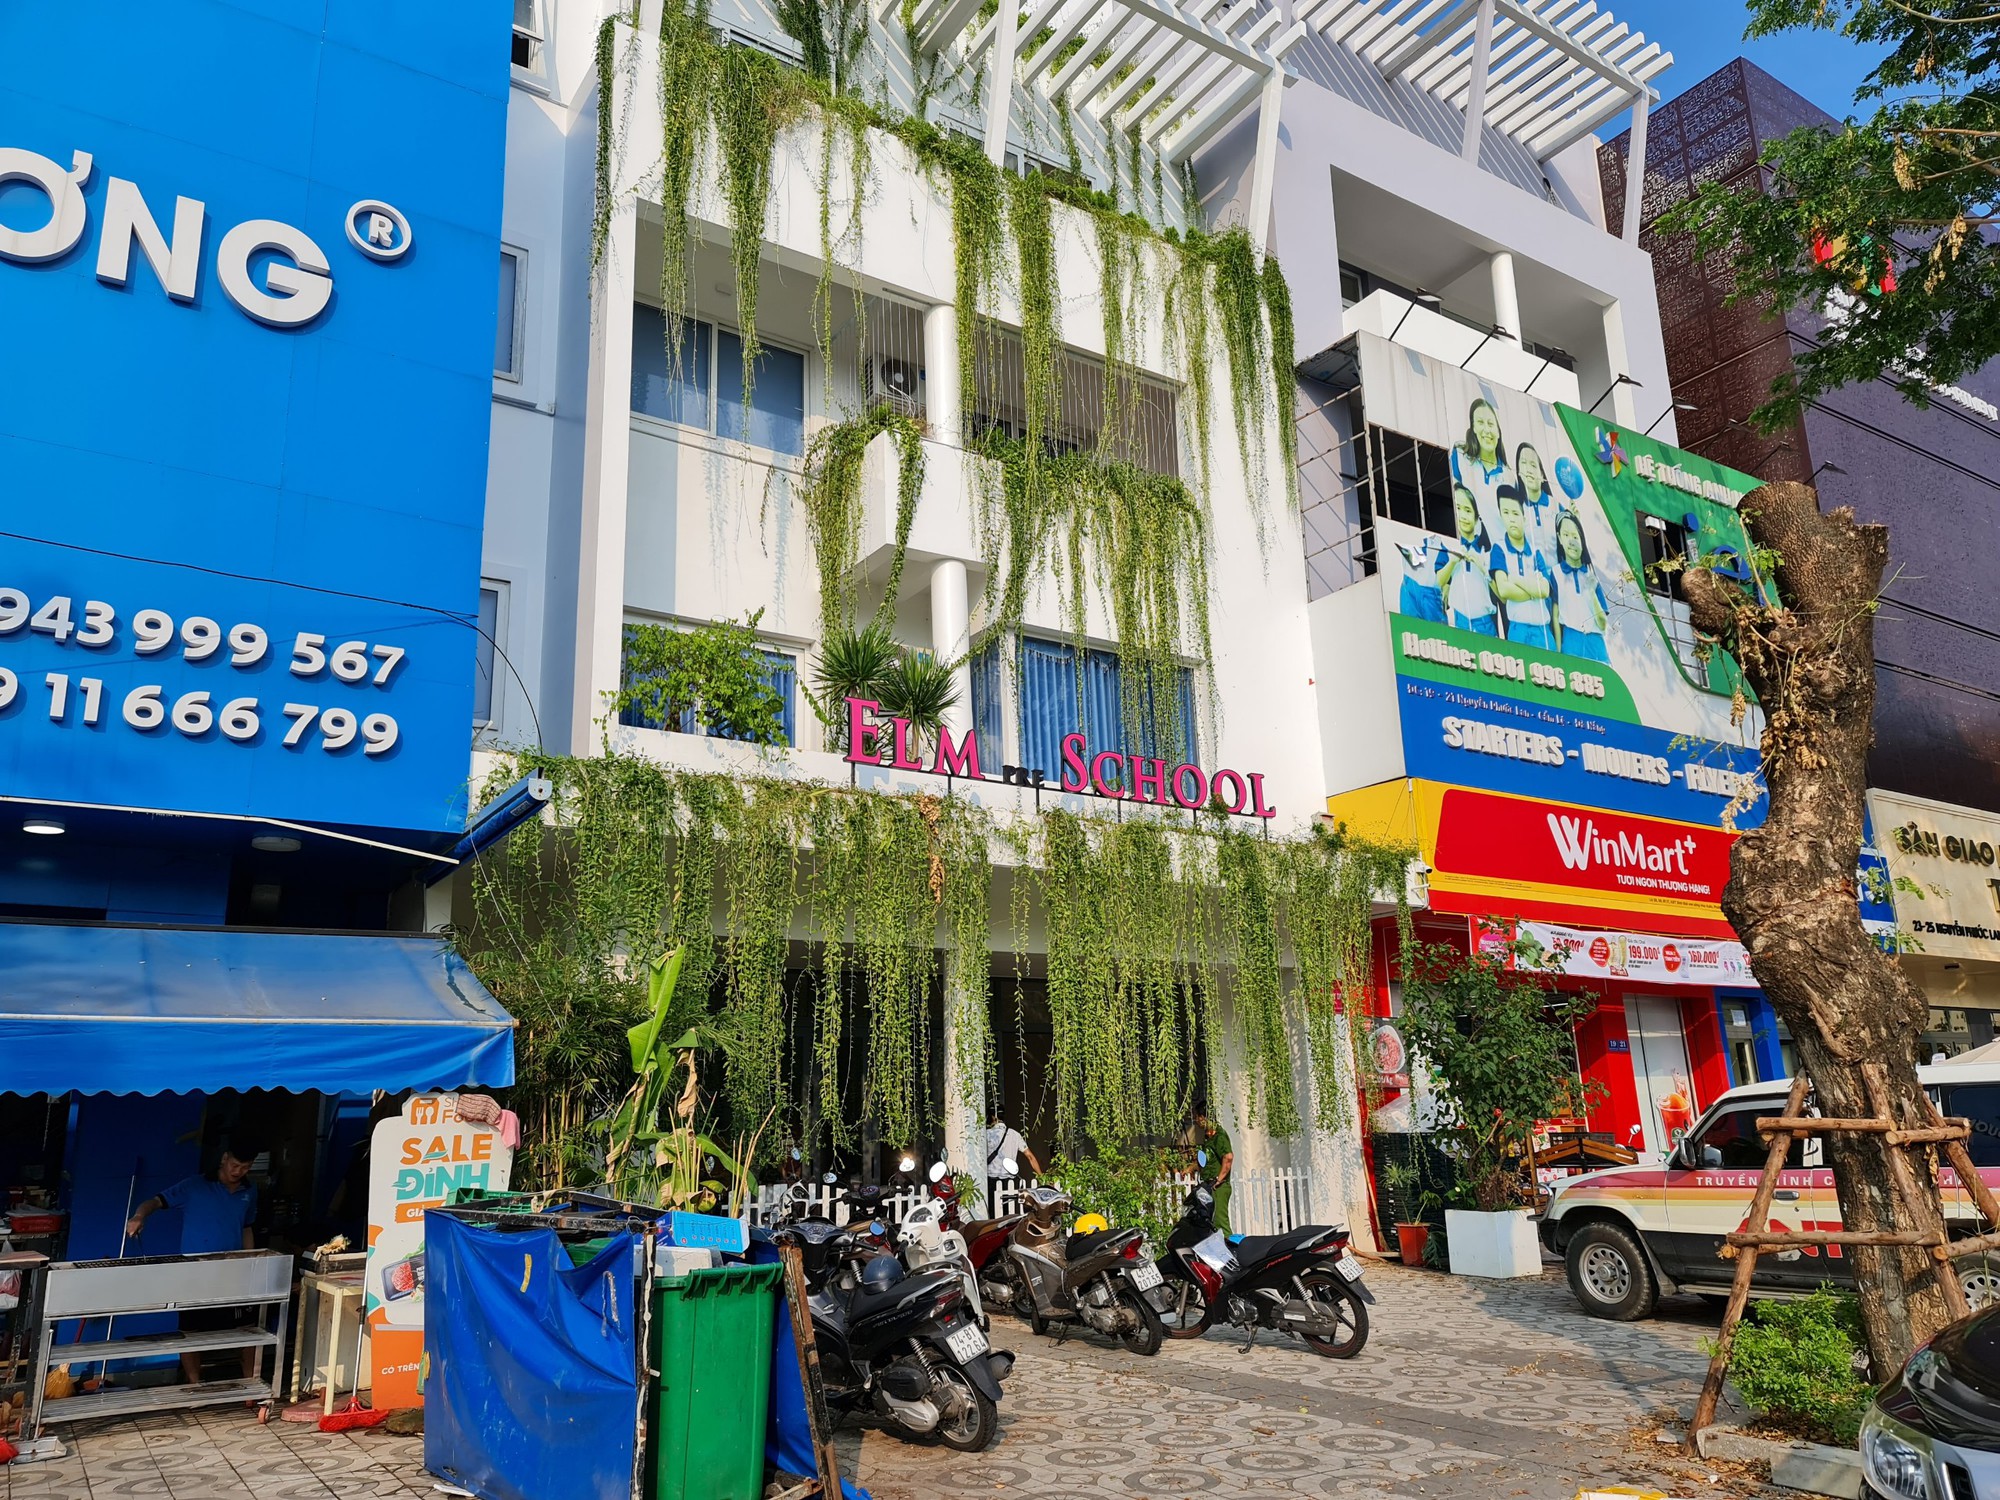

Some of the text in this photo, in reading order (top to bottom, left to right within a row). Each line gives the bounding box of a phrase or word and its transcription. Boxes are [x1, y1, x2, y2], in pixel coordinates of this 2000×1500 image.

[133, 609, 270, 667] 999
[289, 632, 405, 686] 567
[1401, 631, 1606, 699] Hotline: 0901 996 885
[45, 673, 104, 724] 11
[122, 685, 261, 742] 666
[281, 702, 400, 757] 799
[843, 696, 1277, 818] ELM PRE SCHOOL
[1442, 716, 1566, 767] STARTERS
[1581, 742, 1671, 785] MOVERS
[1941, 835, 1995, 866] GIAO
[1635, 876, 1658, 888] NGON
[400, 1134, 493, 1165] SALE
[1696, 1173, 1757, 1185] TRUYỀN
[951, 1326, 976, 1347] 74-B1
[957, 1338, 986, 1362] 122.64
[381, 1361, 420, 1375] CÓ TRÊN
